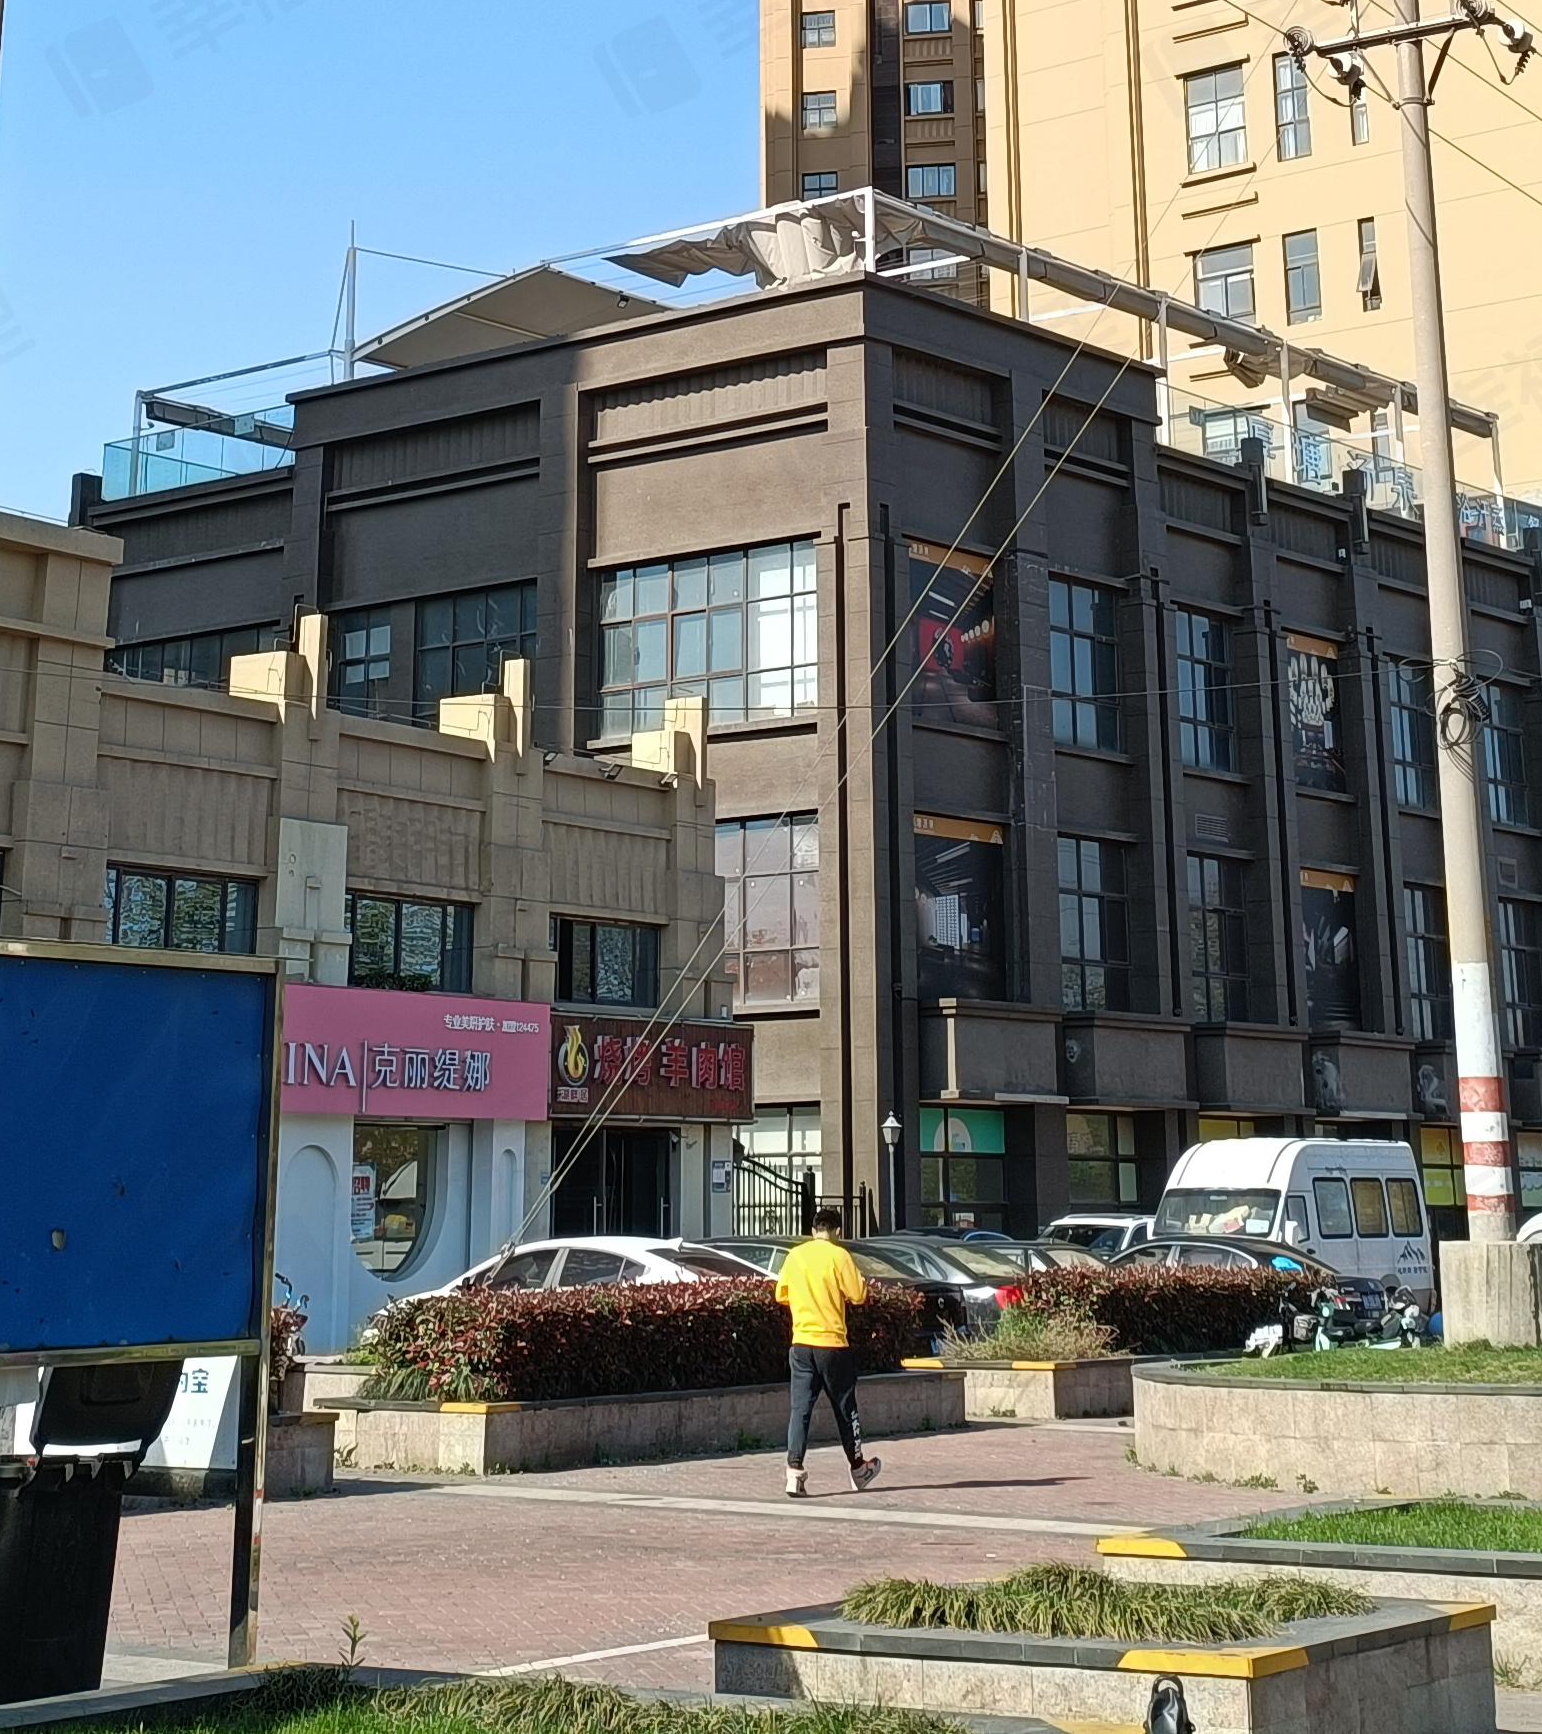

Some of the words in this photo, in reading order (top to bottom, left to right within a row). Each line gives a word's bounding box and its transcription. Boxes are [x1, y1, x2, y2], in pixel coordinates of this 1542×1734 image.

[371, 1042, 491, 1092] 克丽缇娜
[593, 1033, 746, 1091] 烧烤羊肉馆
